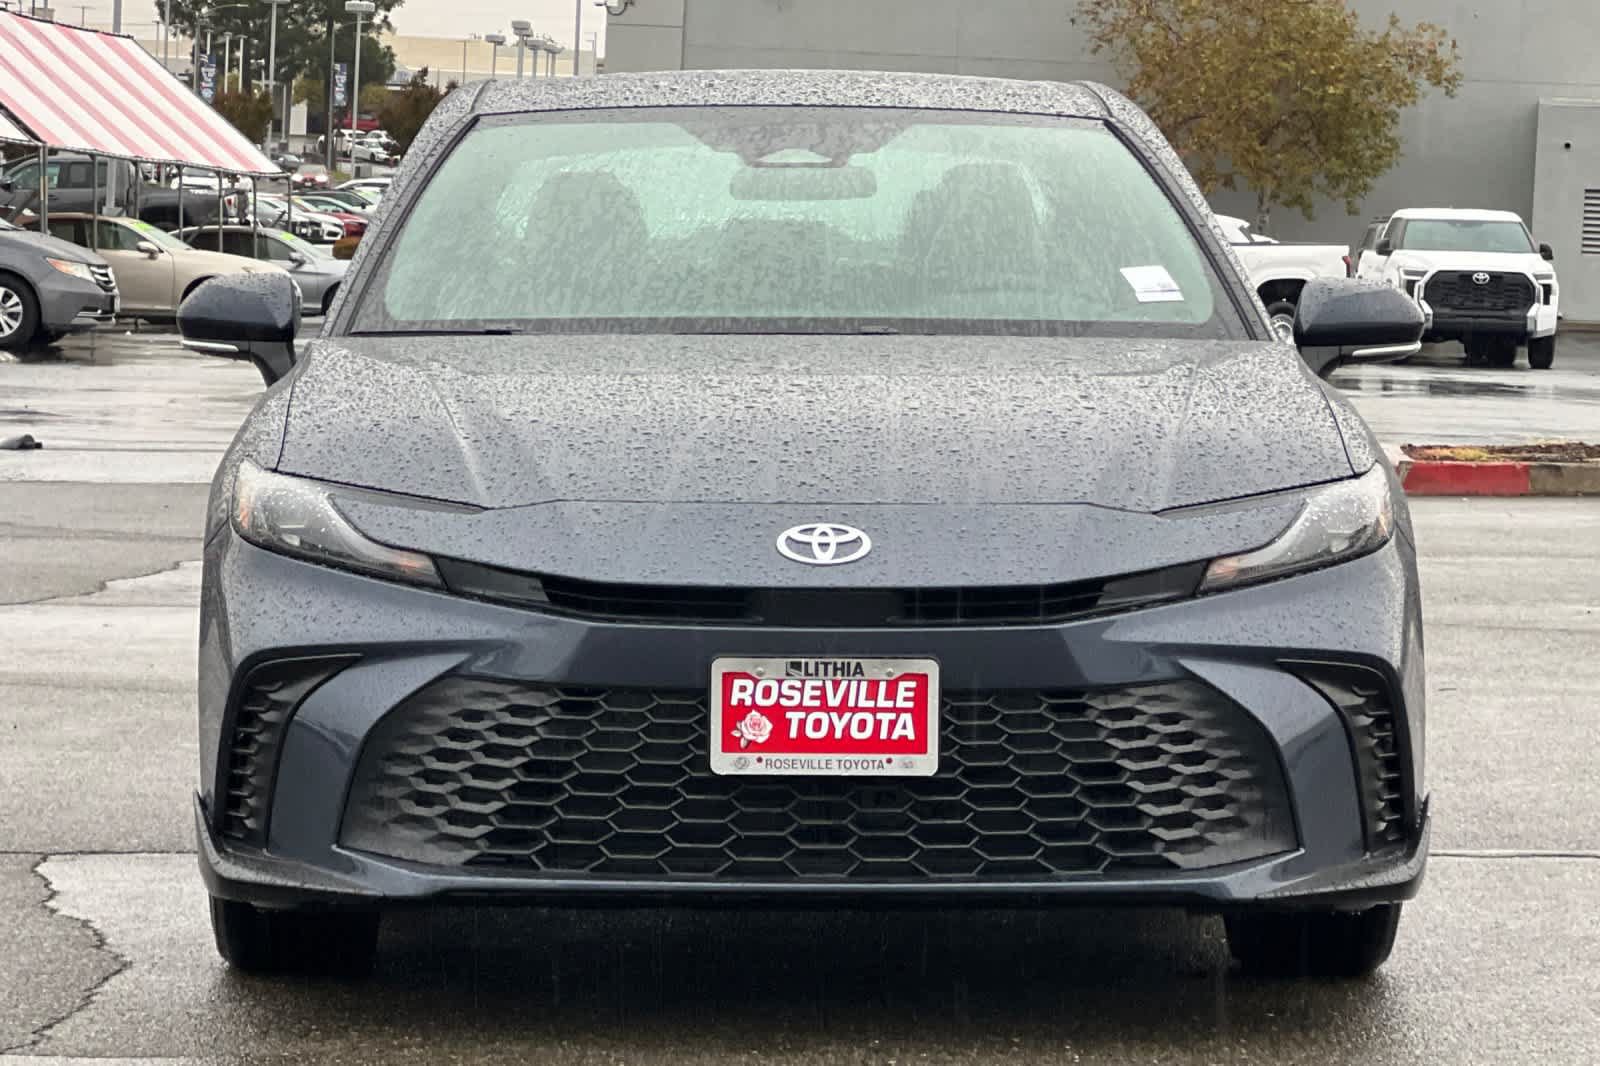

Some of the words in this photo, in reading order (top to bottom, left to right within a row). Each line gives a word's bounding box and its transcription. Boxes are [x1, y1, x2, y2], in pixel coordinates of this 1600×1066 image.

[804, 661, 865, 677] LITHIA
[730, 679, 917, 708] ROSEVILLE
[785, 711, 916, 740] TOYOTA
[765, 758, 832, 770] ROSEVILLE
[835, 758, 885, 770] TOYOTA
